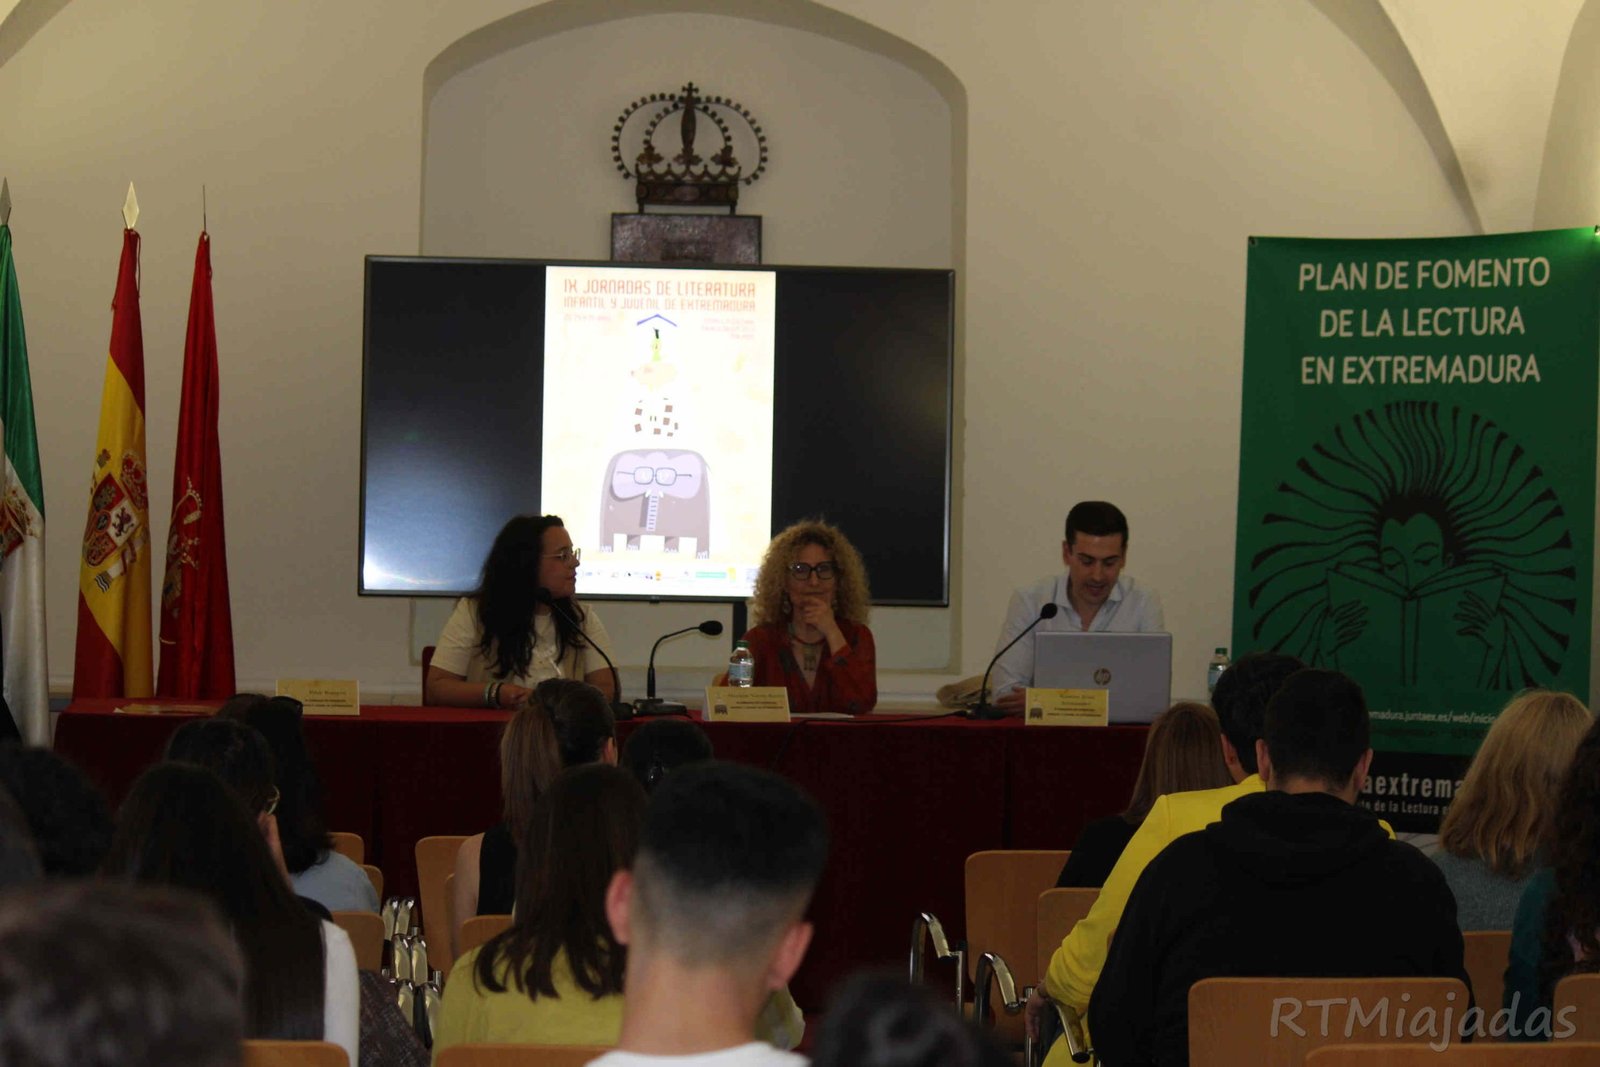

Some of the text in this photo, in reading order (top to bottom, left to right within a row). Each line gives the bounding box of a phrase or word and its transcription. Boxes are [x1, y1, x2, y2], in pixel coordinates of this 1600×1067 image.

[1299, 256, 1551, 292] PLAN DE FOMENTO
[563, 278, 757, 299] IX JORNADAS DE LITERATURA
[563, 296, 605, 309] INFANTIL
[664, 299, 677, 311] DE
[1319, 305, 1526, 338] DE LA LECTURA
[1301, 353, 1542, 385] EN EXTREMADURA
[1361, 772, 1465, 798] aextrem
[1373, 799, 1386, 812] de
